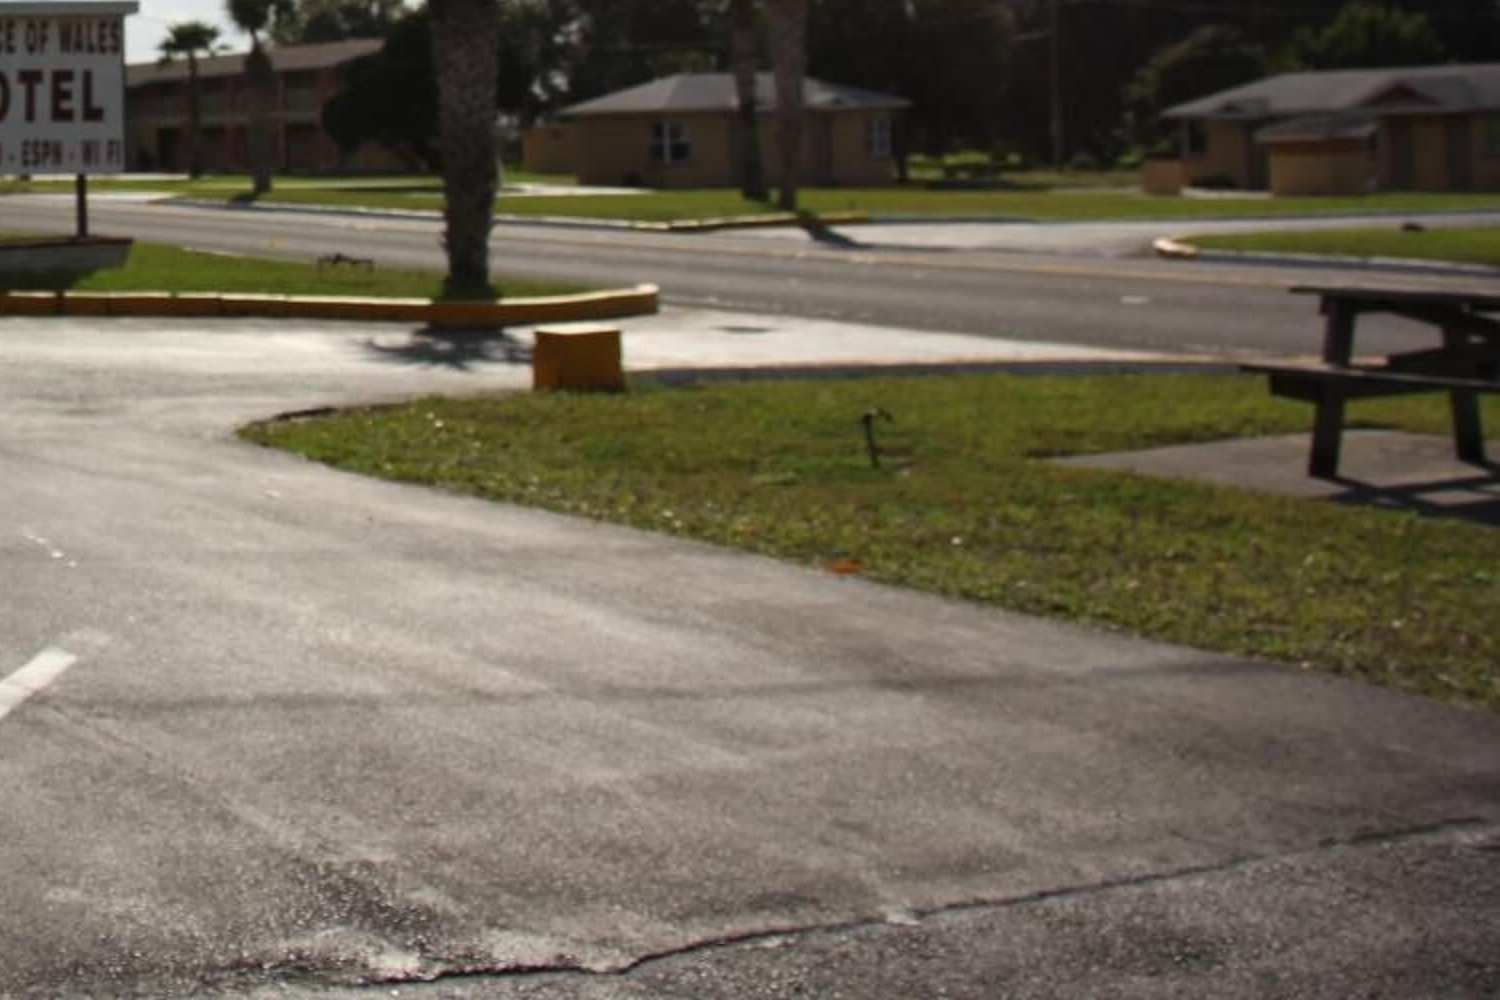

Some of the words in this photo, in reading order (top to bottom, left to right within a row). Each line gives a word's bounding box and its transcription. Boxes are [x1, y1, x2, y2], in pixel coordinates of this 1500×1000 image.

[26, 23, 49, 54] OF
[58, 22, 122, 54] WALES
[22, 140, 64, 168] ESPN
